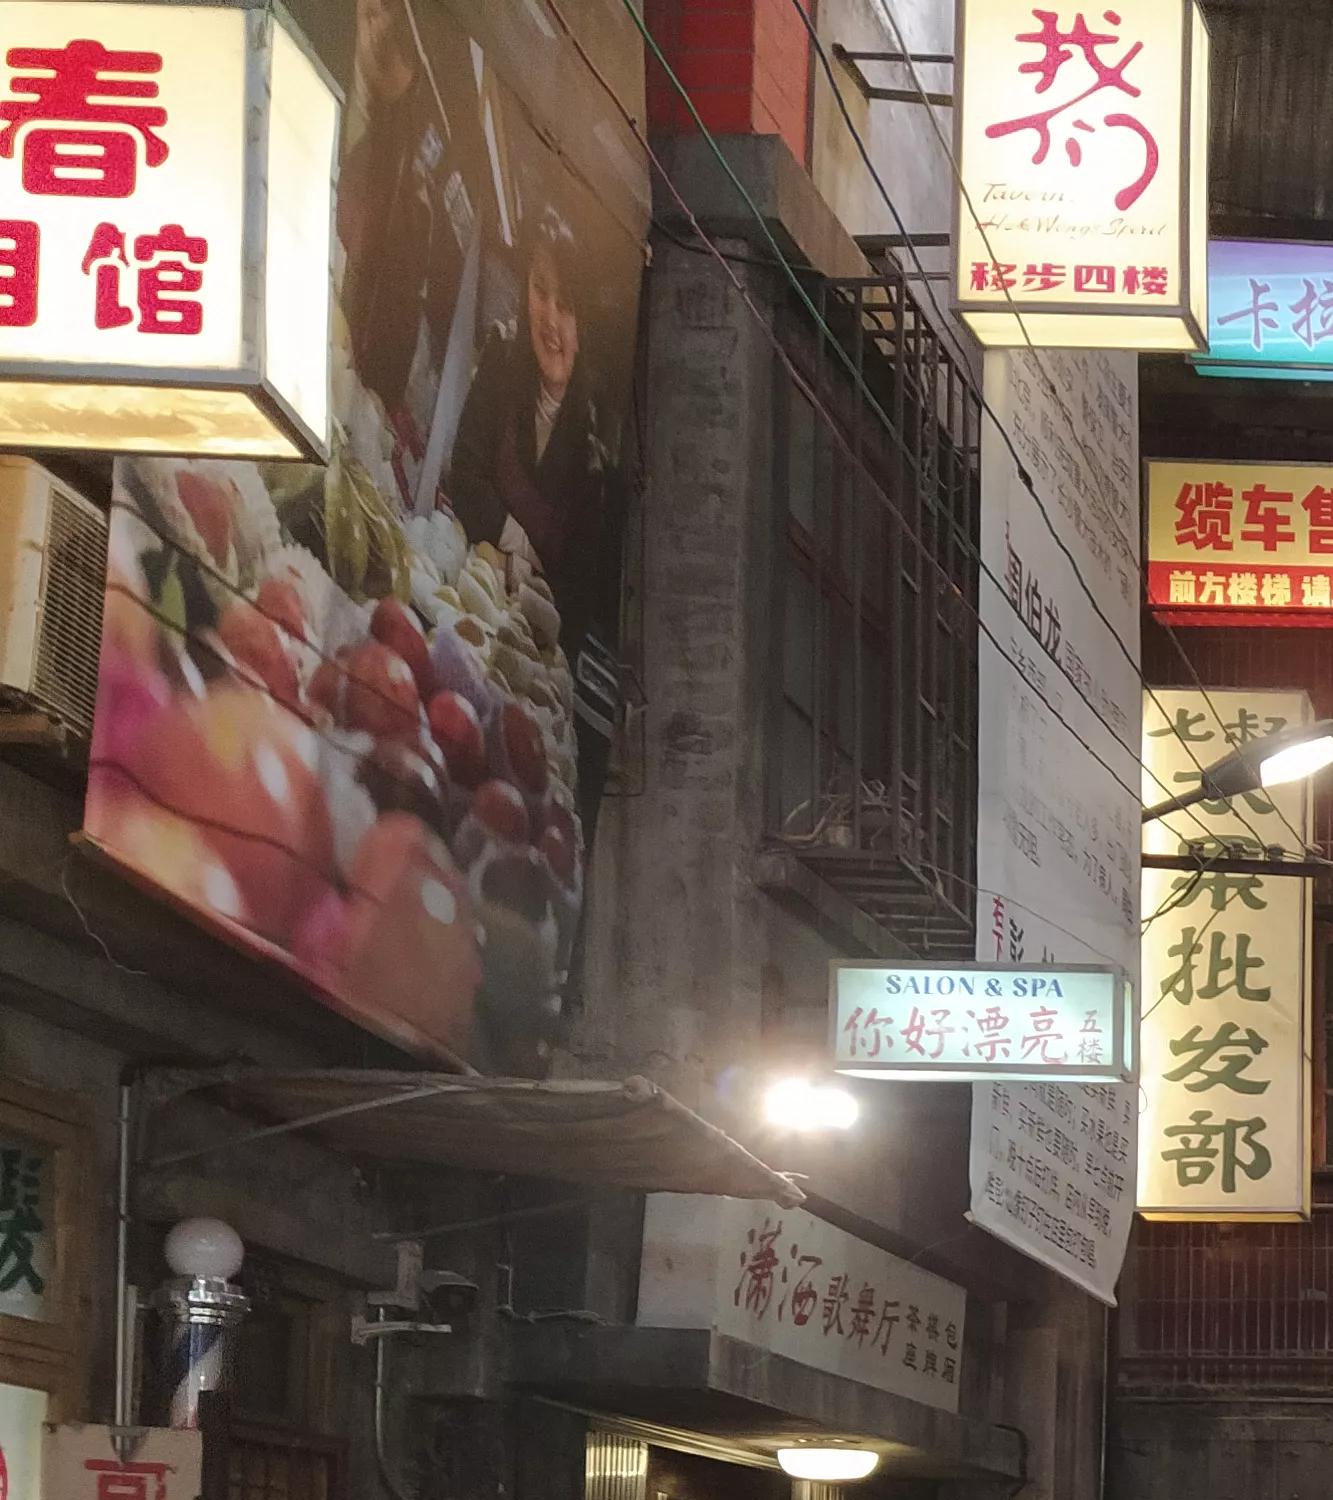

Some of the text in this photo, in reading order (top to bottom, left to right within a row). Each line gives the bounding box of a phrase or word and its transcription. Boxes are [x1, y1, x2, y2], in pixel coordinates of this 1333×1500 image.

[0, 39, 170, 198] 春
[969, 261, 1169, 295] 移步四楼
[1168, 570, 1293, 606] 前方楼梯
[885, 974, 1064, 998] SALON & SPA
[843, 1006, 1068, 1065] 你好漂亮
[1077, 1009, 1104, 1064] 五楼
